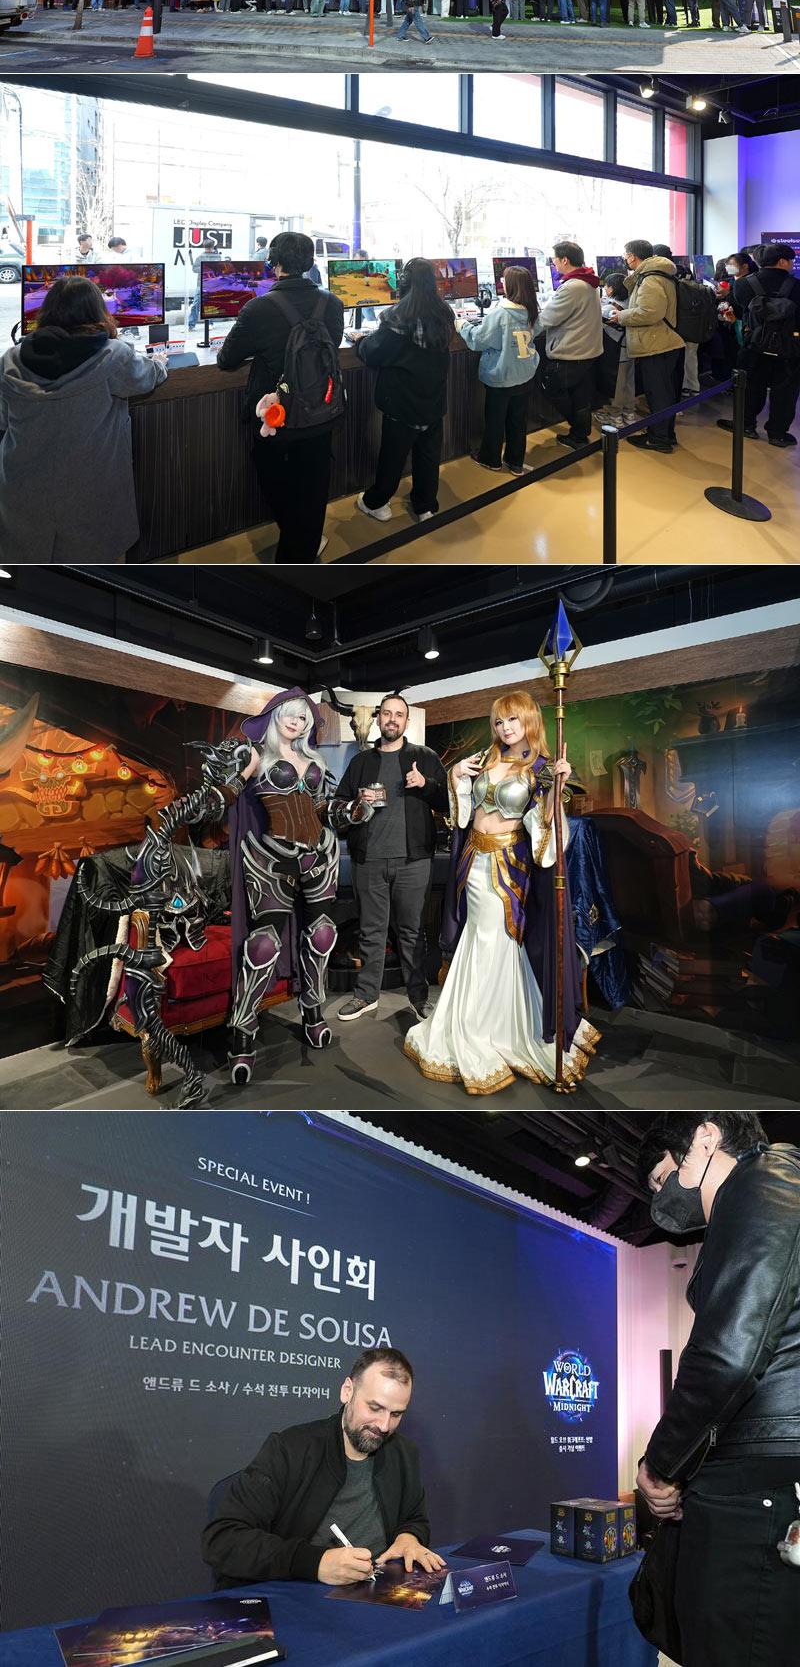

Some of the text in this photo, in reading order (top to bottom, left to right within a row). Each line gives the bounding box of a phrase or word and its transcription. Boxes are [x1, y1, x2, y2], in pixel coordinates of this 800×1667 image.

[175, 230, 231, 247] JUST
[512, 331, 536, 359] R
[198, 1157, 258, 1187] SPECIAL
[263, 1179, 304, 1201] EVENT
[76, 1183, 376, 1301] 개발자 사인회
[26, 1270, 392, 1348] ANDREW DE SOUSA
[129, 1335, 341, 1369] LEAD ENCOUNTER DESIGNER
[553, 1360, 591, 1376] WORLD
[142, 1376, 184, 1391] 앤드류
[188, 1379, 201, 1391] 드
[205, 1382, 230, 1395] 소사
[242, 1383, 265, 1396] 수석
[268, 1384, 289, 1397] 전투
[292, 1386, 330, 1399] 디자이너
[542, 1371, 600, 1401] WARCRAFT
[553, 1402, 591, 1413] MIDNIGHT
